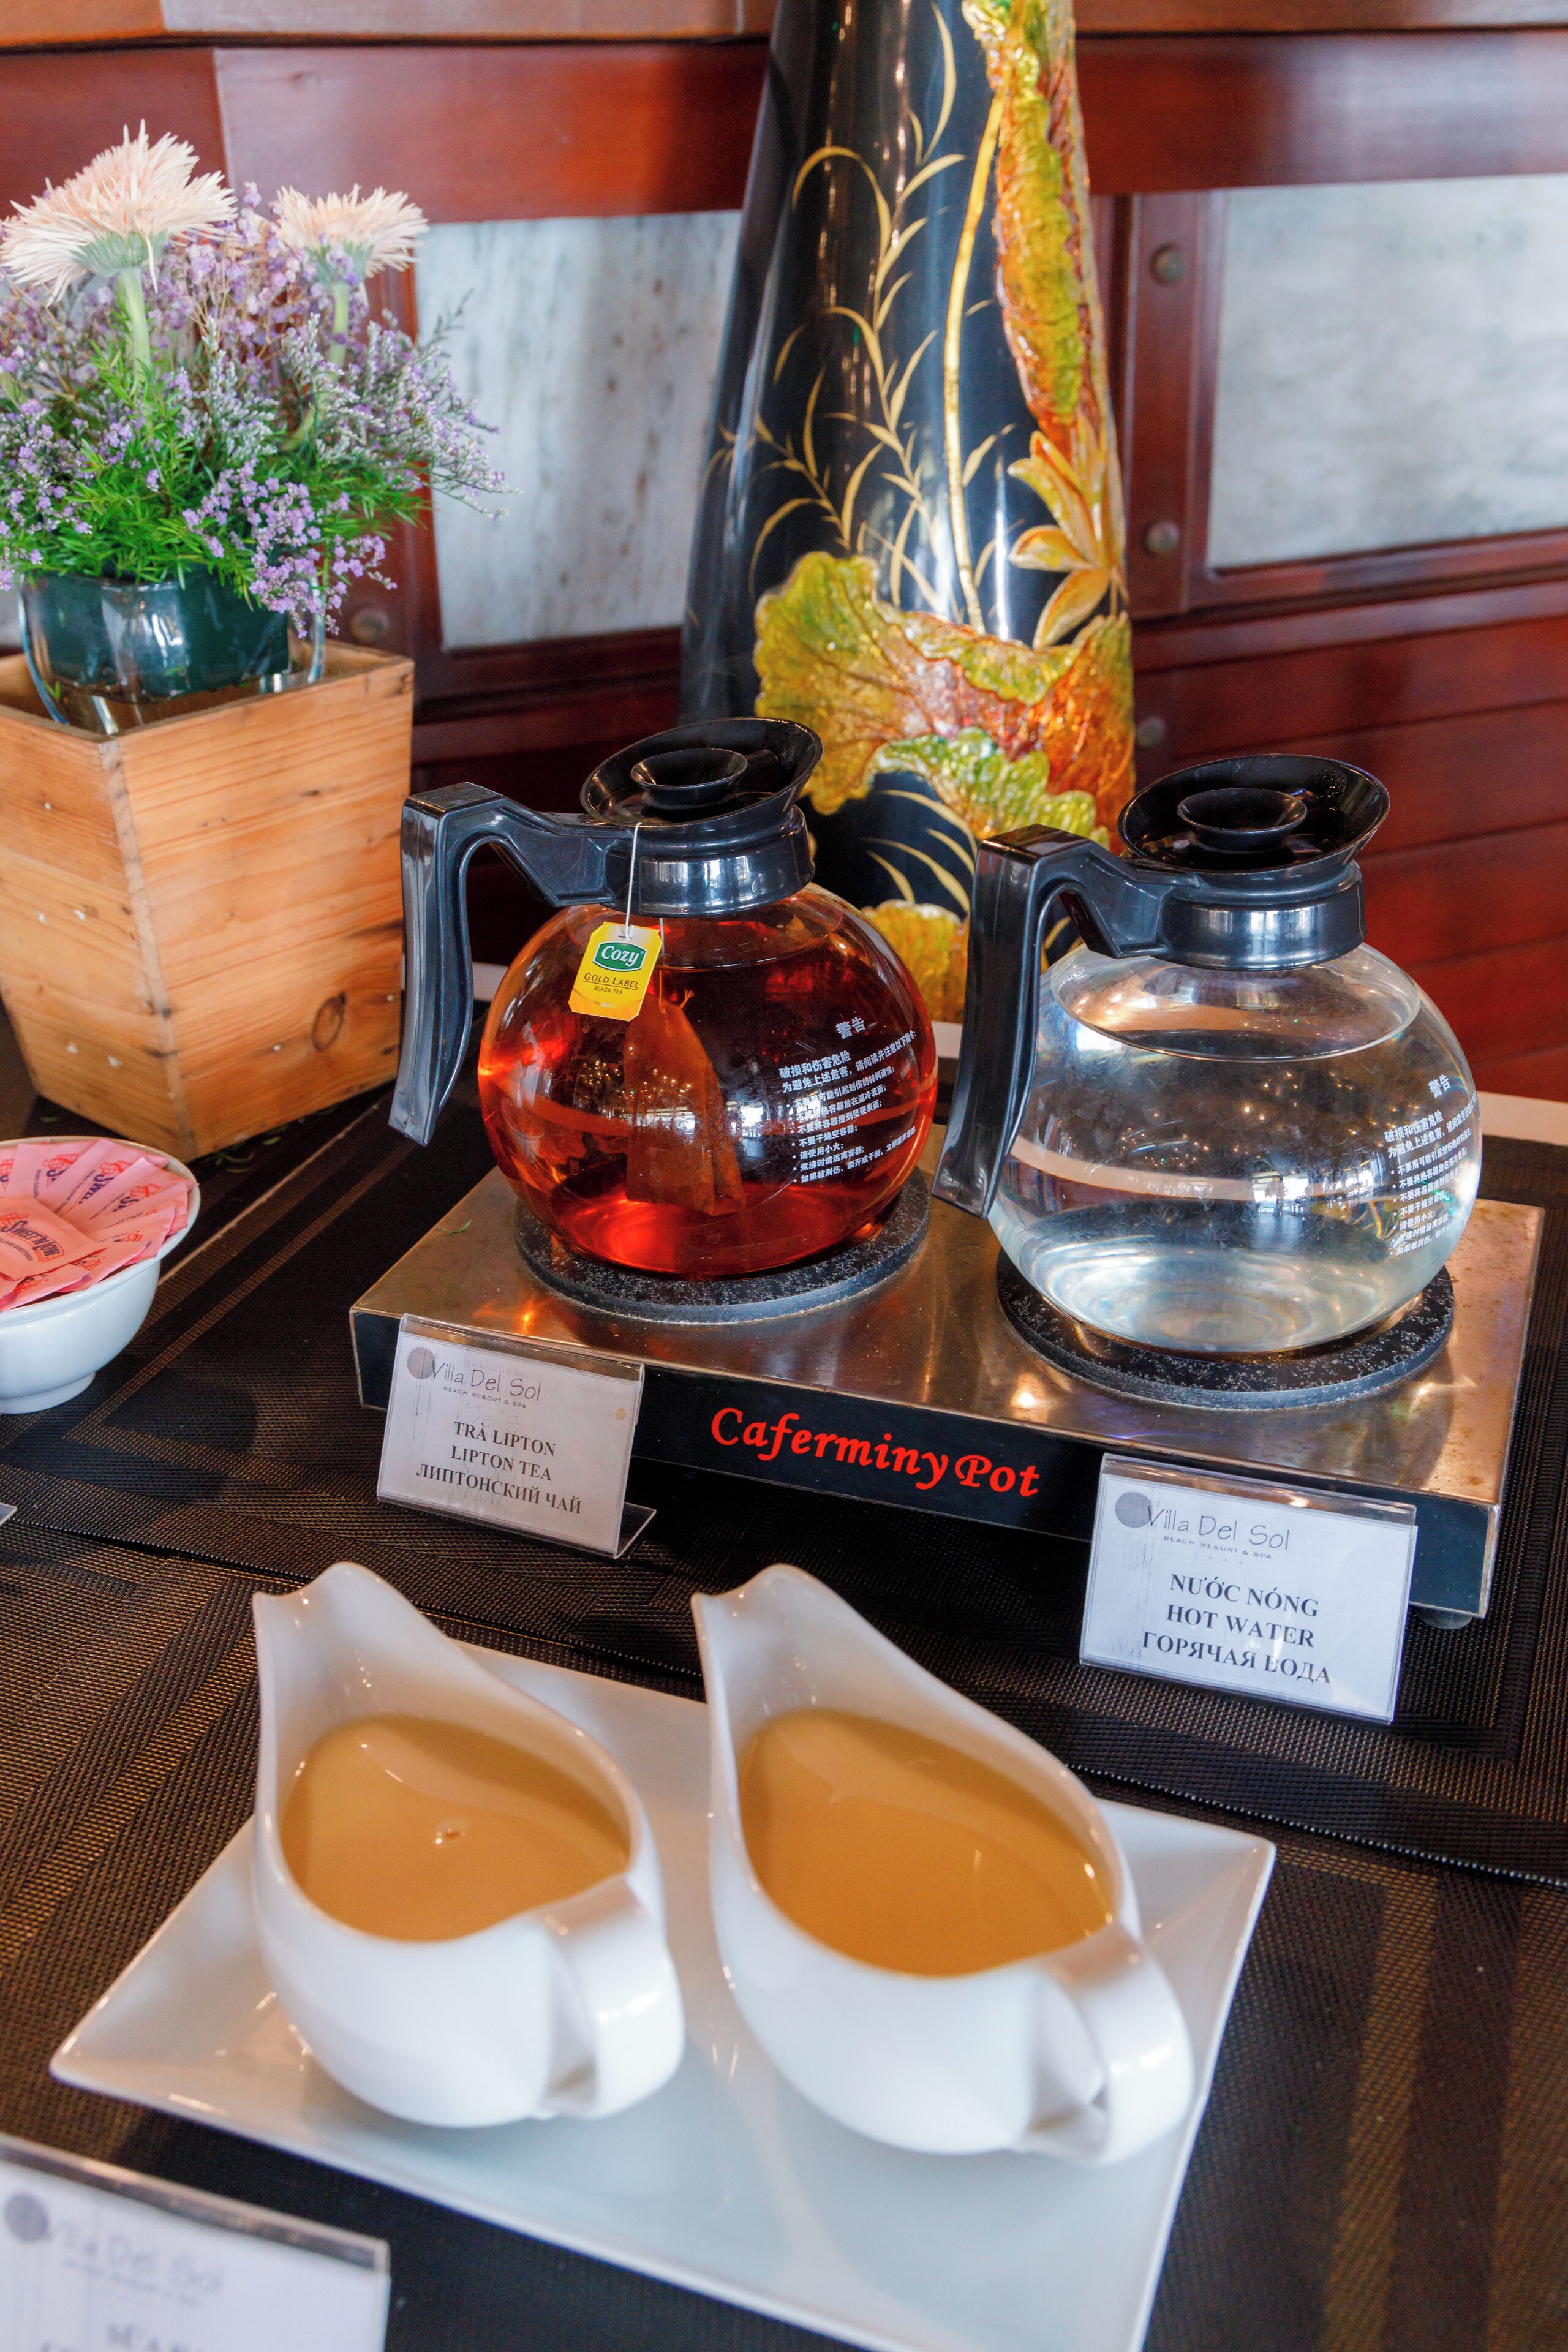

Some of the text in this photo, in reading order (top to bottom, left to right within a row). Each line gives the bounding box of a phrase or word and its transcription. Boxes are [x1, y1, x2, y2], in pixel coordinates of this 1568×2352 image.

[601, 945, 640, 967] Cozy
[584, 973, 639, 989] GOLD LABEL
[835, 1016, 866, 1039] 警告
[779, 1050, 851, 1079] 破损和伤害危险
[1428, 1074, 1451, 1099] 警告
[1384, 1110, 1444, 1143] 破损和伤害危险
[432, 1360, 541, 1401] Villa Del Sol
[443, 1385, 468, 1395] BEACH
[472, 1392, 502, 1403] RESORT
[454, 1421, 557, 1457] TRÀ LIPTON
[451, 1445, 552, 1481] LIPTON TEA
[416, 1463, 582, 1515] ЛИПТОНСКИЙ ЧАЙ
[1147, 1504, 1291, 1550] Villa Del Sol
[1169, 1574, 1320, 1618] NƯỚC NÓNG
[1166, 1604, 1315, 1648] HOT WATER
[1142, 1630, 1257, 1670] ГОРЯЧАЯ
